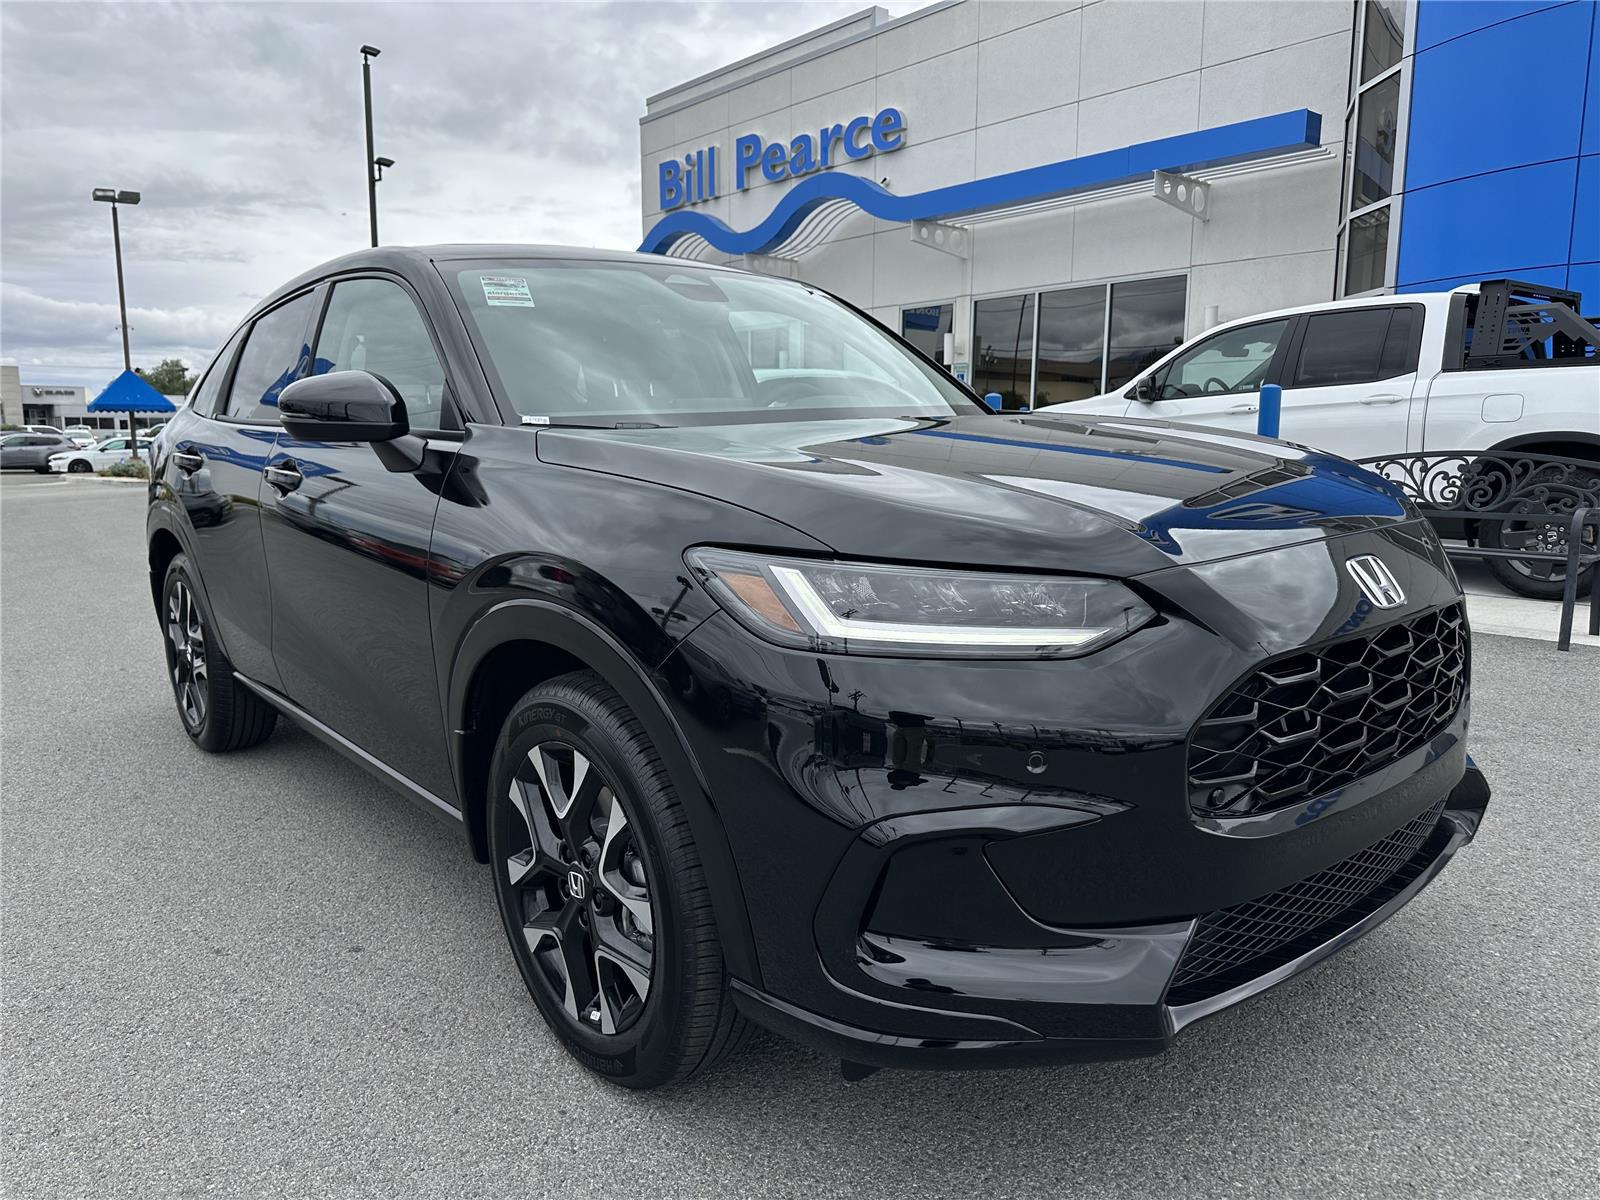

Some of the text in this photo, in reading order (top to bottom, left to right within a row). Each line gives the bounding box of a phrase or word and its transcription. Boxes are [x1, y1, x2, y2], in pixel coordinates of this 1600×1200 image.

[659, 107, 905, 211] Bill Pearce
[517, 707, 555, 728] KINERGY
